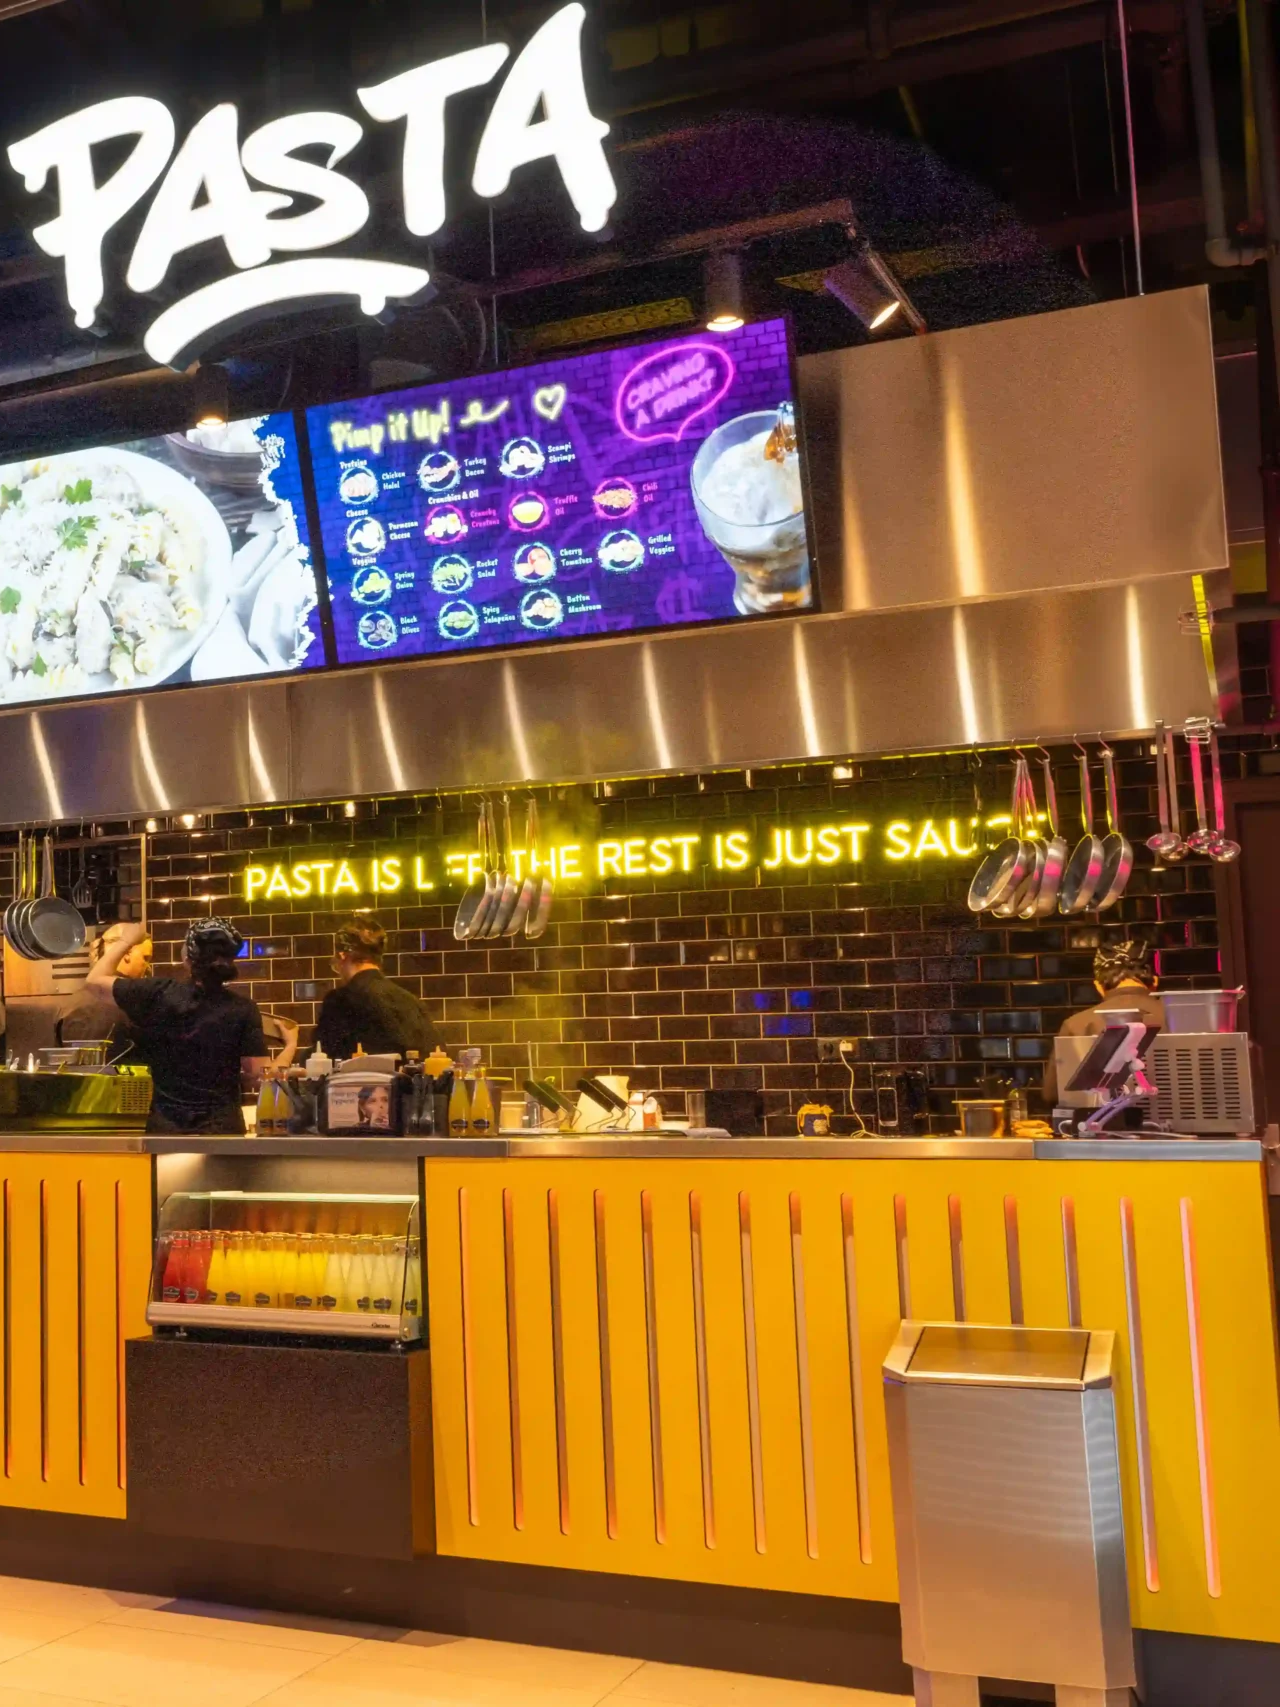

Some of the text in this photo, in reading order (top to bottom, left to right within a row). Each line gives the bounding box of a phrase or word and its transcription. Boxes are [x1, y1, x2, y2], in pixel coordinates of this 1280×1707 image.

[7, 2, 617, 329] PASTA
[627, 352, 706, 410] CRAVING
[636, 409, 651, 429] A
[330, 400, 450, 454] Pimp it Up!
[547, 442, 571, 453] Scampi
[464, 457, 487, 466] Turkey
[549, 453, 575, 464] Shrimps
[382, 472, 405, 480] Chicken
[465, 469, 484, 477] Bacon
[383, 481, 400, 490] Halal
[428, 489, 479, 505] Crunchies & Oil
[346, 509, 368, 517] Cheese
[388, 521, 418, 530] Parmesan
[390, 532, 410, 540] Cheese
[648, 534, 672, 544] Grilled
[559, 549, 583, 558] Cherry
[649, 545, 675, 555] Veggies
[476, 558, 498, 568] Rocket
[561, 557, 593, 567] Tomatoes
[394, 571, 415, 581] Spring
[477, 569, 496, 578] Salad
[567, 594, 590, 603] Button
[483, 606, 500, 615] Spicy
[568, 603, 602, 613] Mushroom
[400, 616, 417, 625] Black
[402, 626, 420, 635] Olives
[246, 860, 360, 901] PASTA
[372, 857, 402, 893] IS
[510, 845, 583, 883] THE
[598, 836, 700, 876] REST
[716, 832, 750, 869] IS
[763, 824, 870, 868] JUST
[884, 813, 1048, 860] SAU
